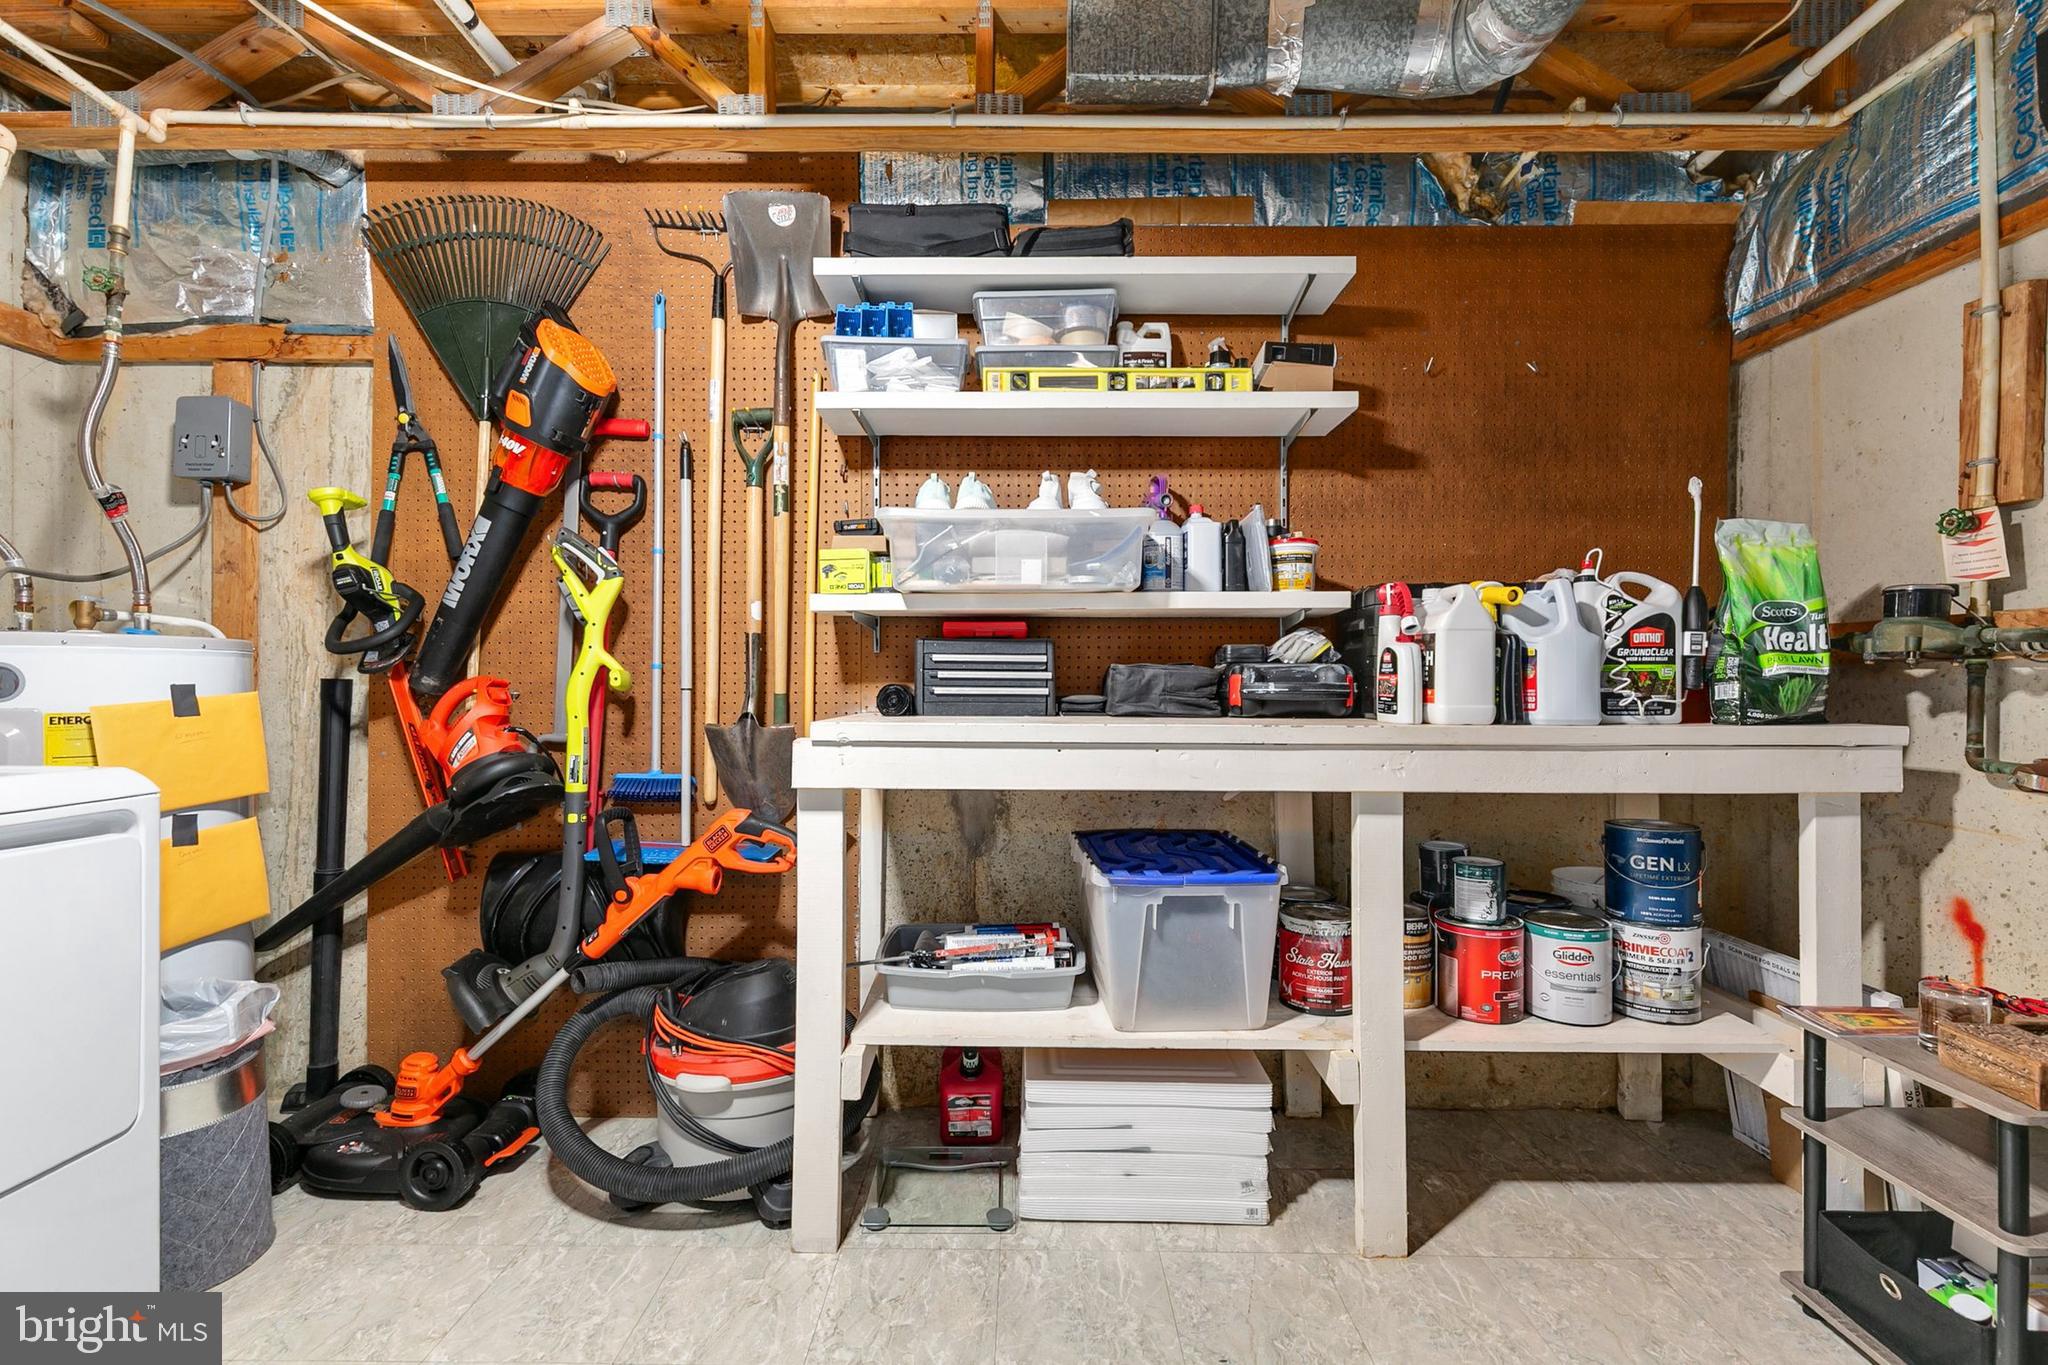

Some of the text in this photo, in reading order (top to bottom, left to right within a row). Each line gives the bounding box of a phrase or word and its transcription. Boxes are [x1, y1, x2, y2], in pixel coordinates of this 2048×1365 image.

[443, 515, 492, 608] WORX
[1761, 606, 1799, 618] Scotts
[1633, 632, 1662, 644] ORTHO
[1763, 623, 1829, 652] Healt
[1790, 655, 1824, 665] LAWN
[49, 716, 93, 726] ENERG
[1629, 854, 1691, 872] GEN LX
[1286, 947, 1315, 967] State
[1553, 950, 1595, 962] Glidden
[1656, 957, 1686, 965] SEALER
[1688, 951, 1694, 962] 2
[1307, 968, 1333, 976] EXTERIOR
[1771, 962, 1791, 974] DEALS
[1544, 969, 1602, 982] essentials
[1905, 1090, 1914, 1102] 20
